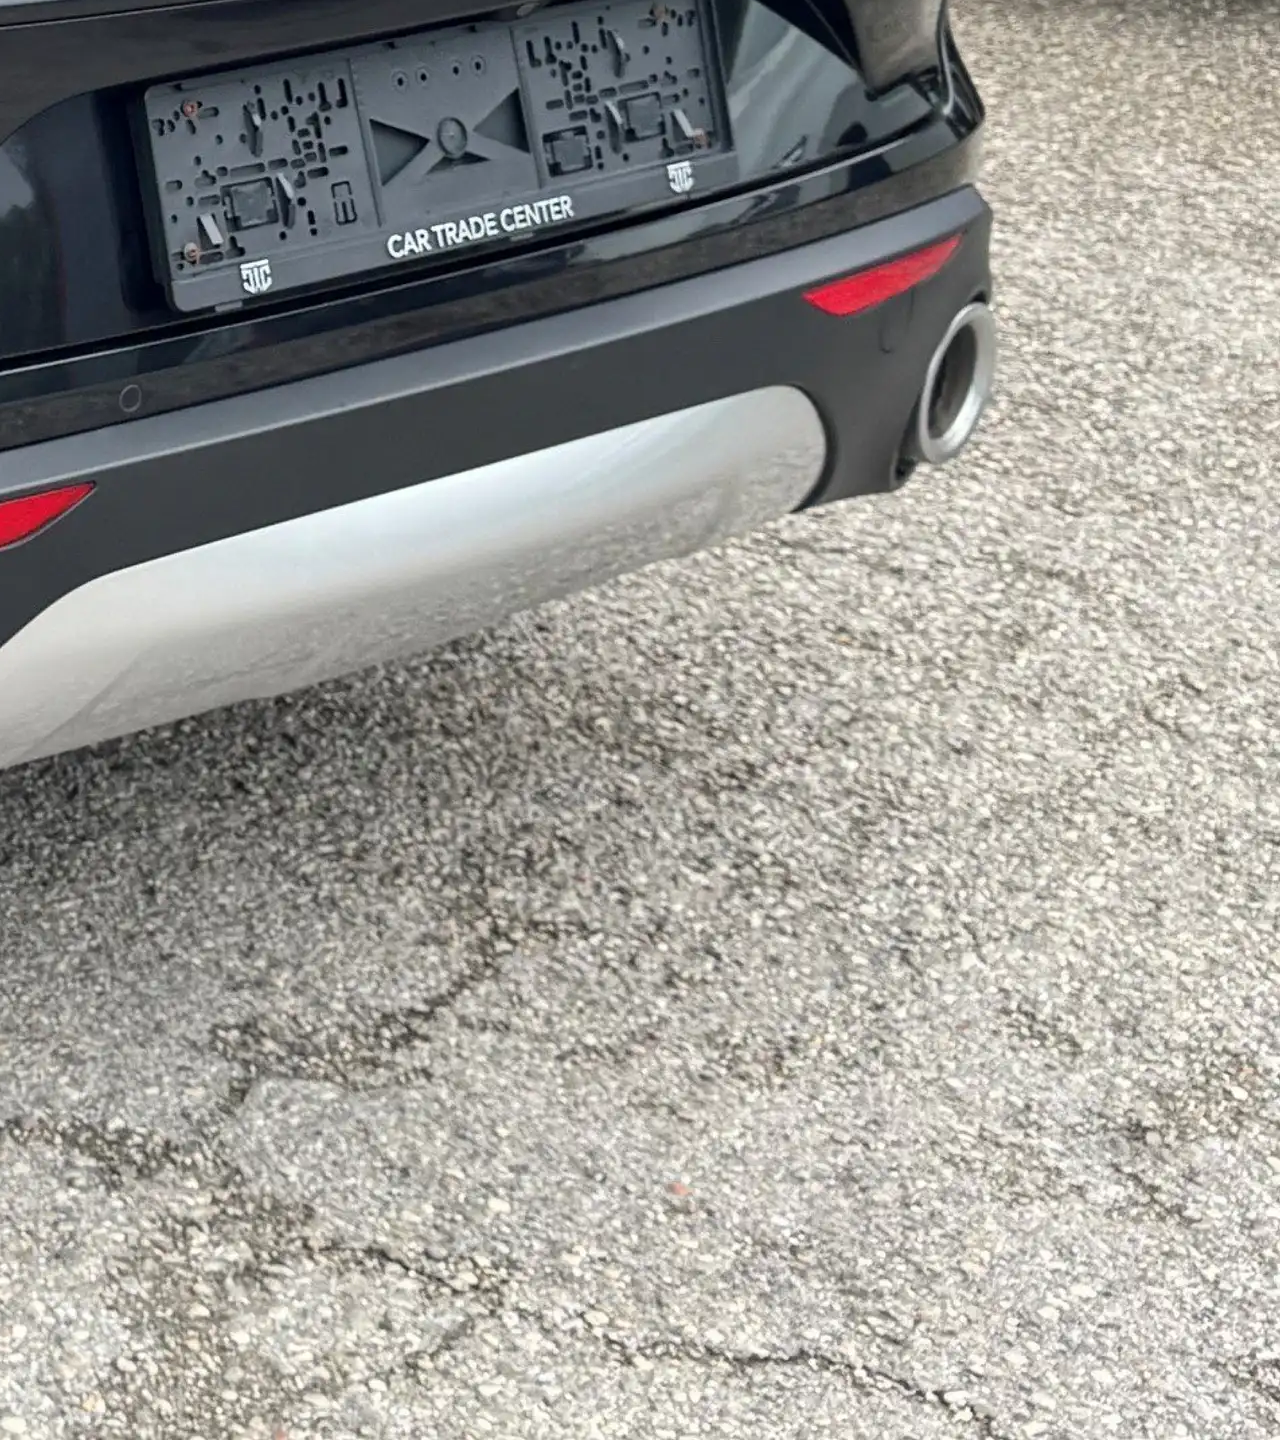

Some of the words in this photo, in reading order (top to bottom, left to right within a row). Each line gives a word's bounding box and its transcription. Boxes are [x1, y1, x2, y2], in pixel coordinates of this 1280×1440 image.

[386, 232, 433, 259] CAR
[431, 213, 498, 249] TRADE
[499, 195, 575, 233] CENTER
